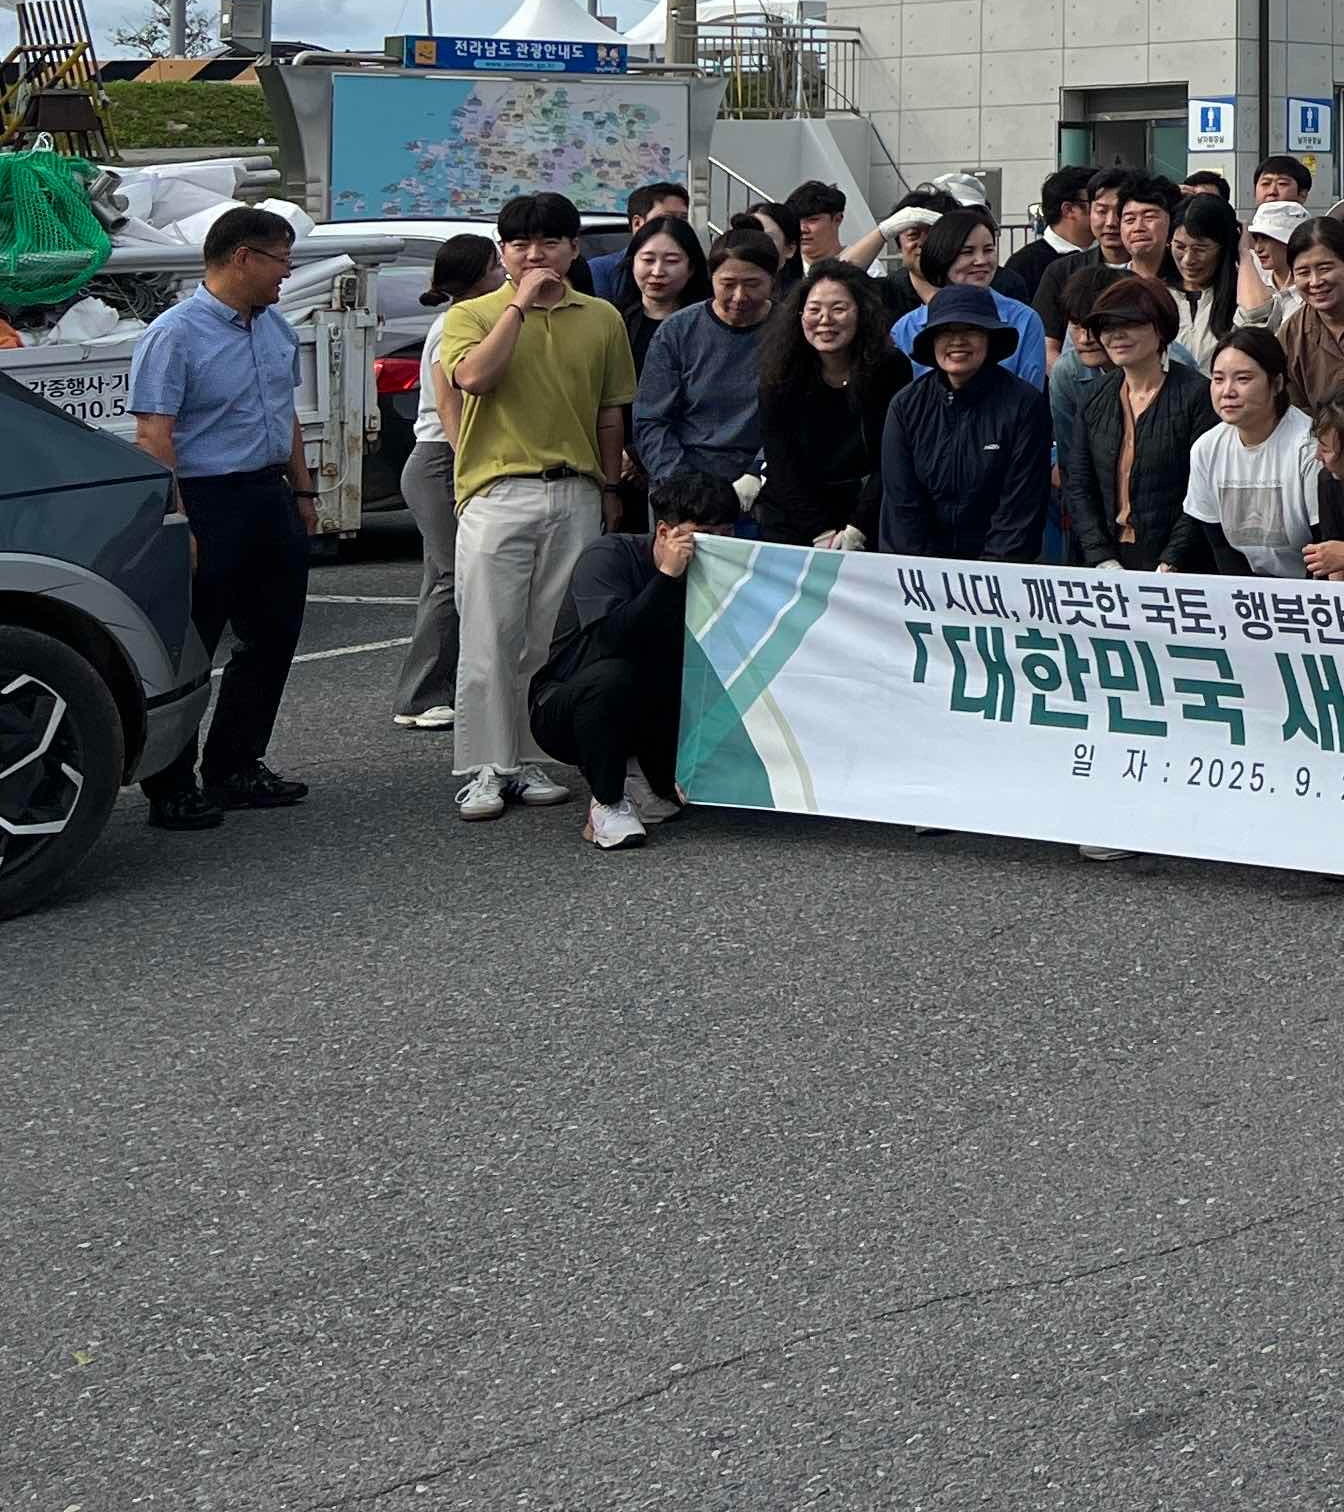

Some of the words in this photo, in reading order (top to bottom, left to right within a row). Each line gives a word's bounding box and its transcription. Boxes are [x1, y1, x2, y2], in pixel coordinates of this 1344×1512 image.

[455, 40, 511, 57] 전라남도
[516, 43, 585, 59] 관광안내도
[897, 568, 935, 612] 새
[943, 572, 1021, 624] 시대,
[1022, 577, 1130, 631] 깨끗한
[1138, 585, 1227, 641] 국토,
[1187, 756, 1276, 793] 2025.
[1295, 766, 1322, 798] 9.
